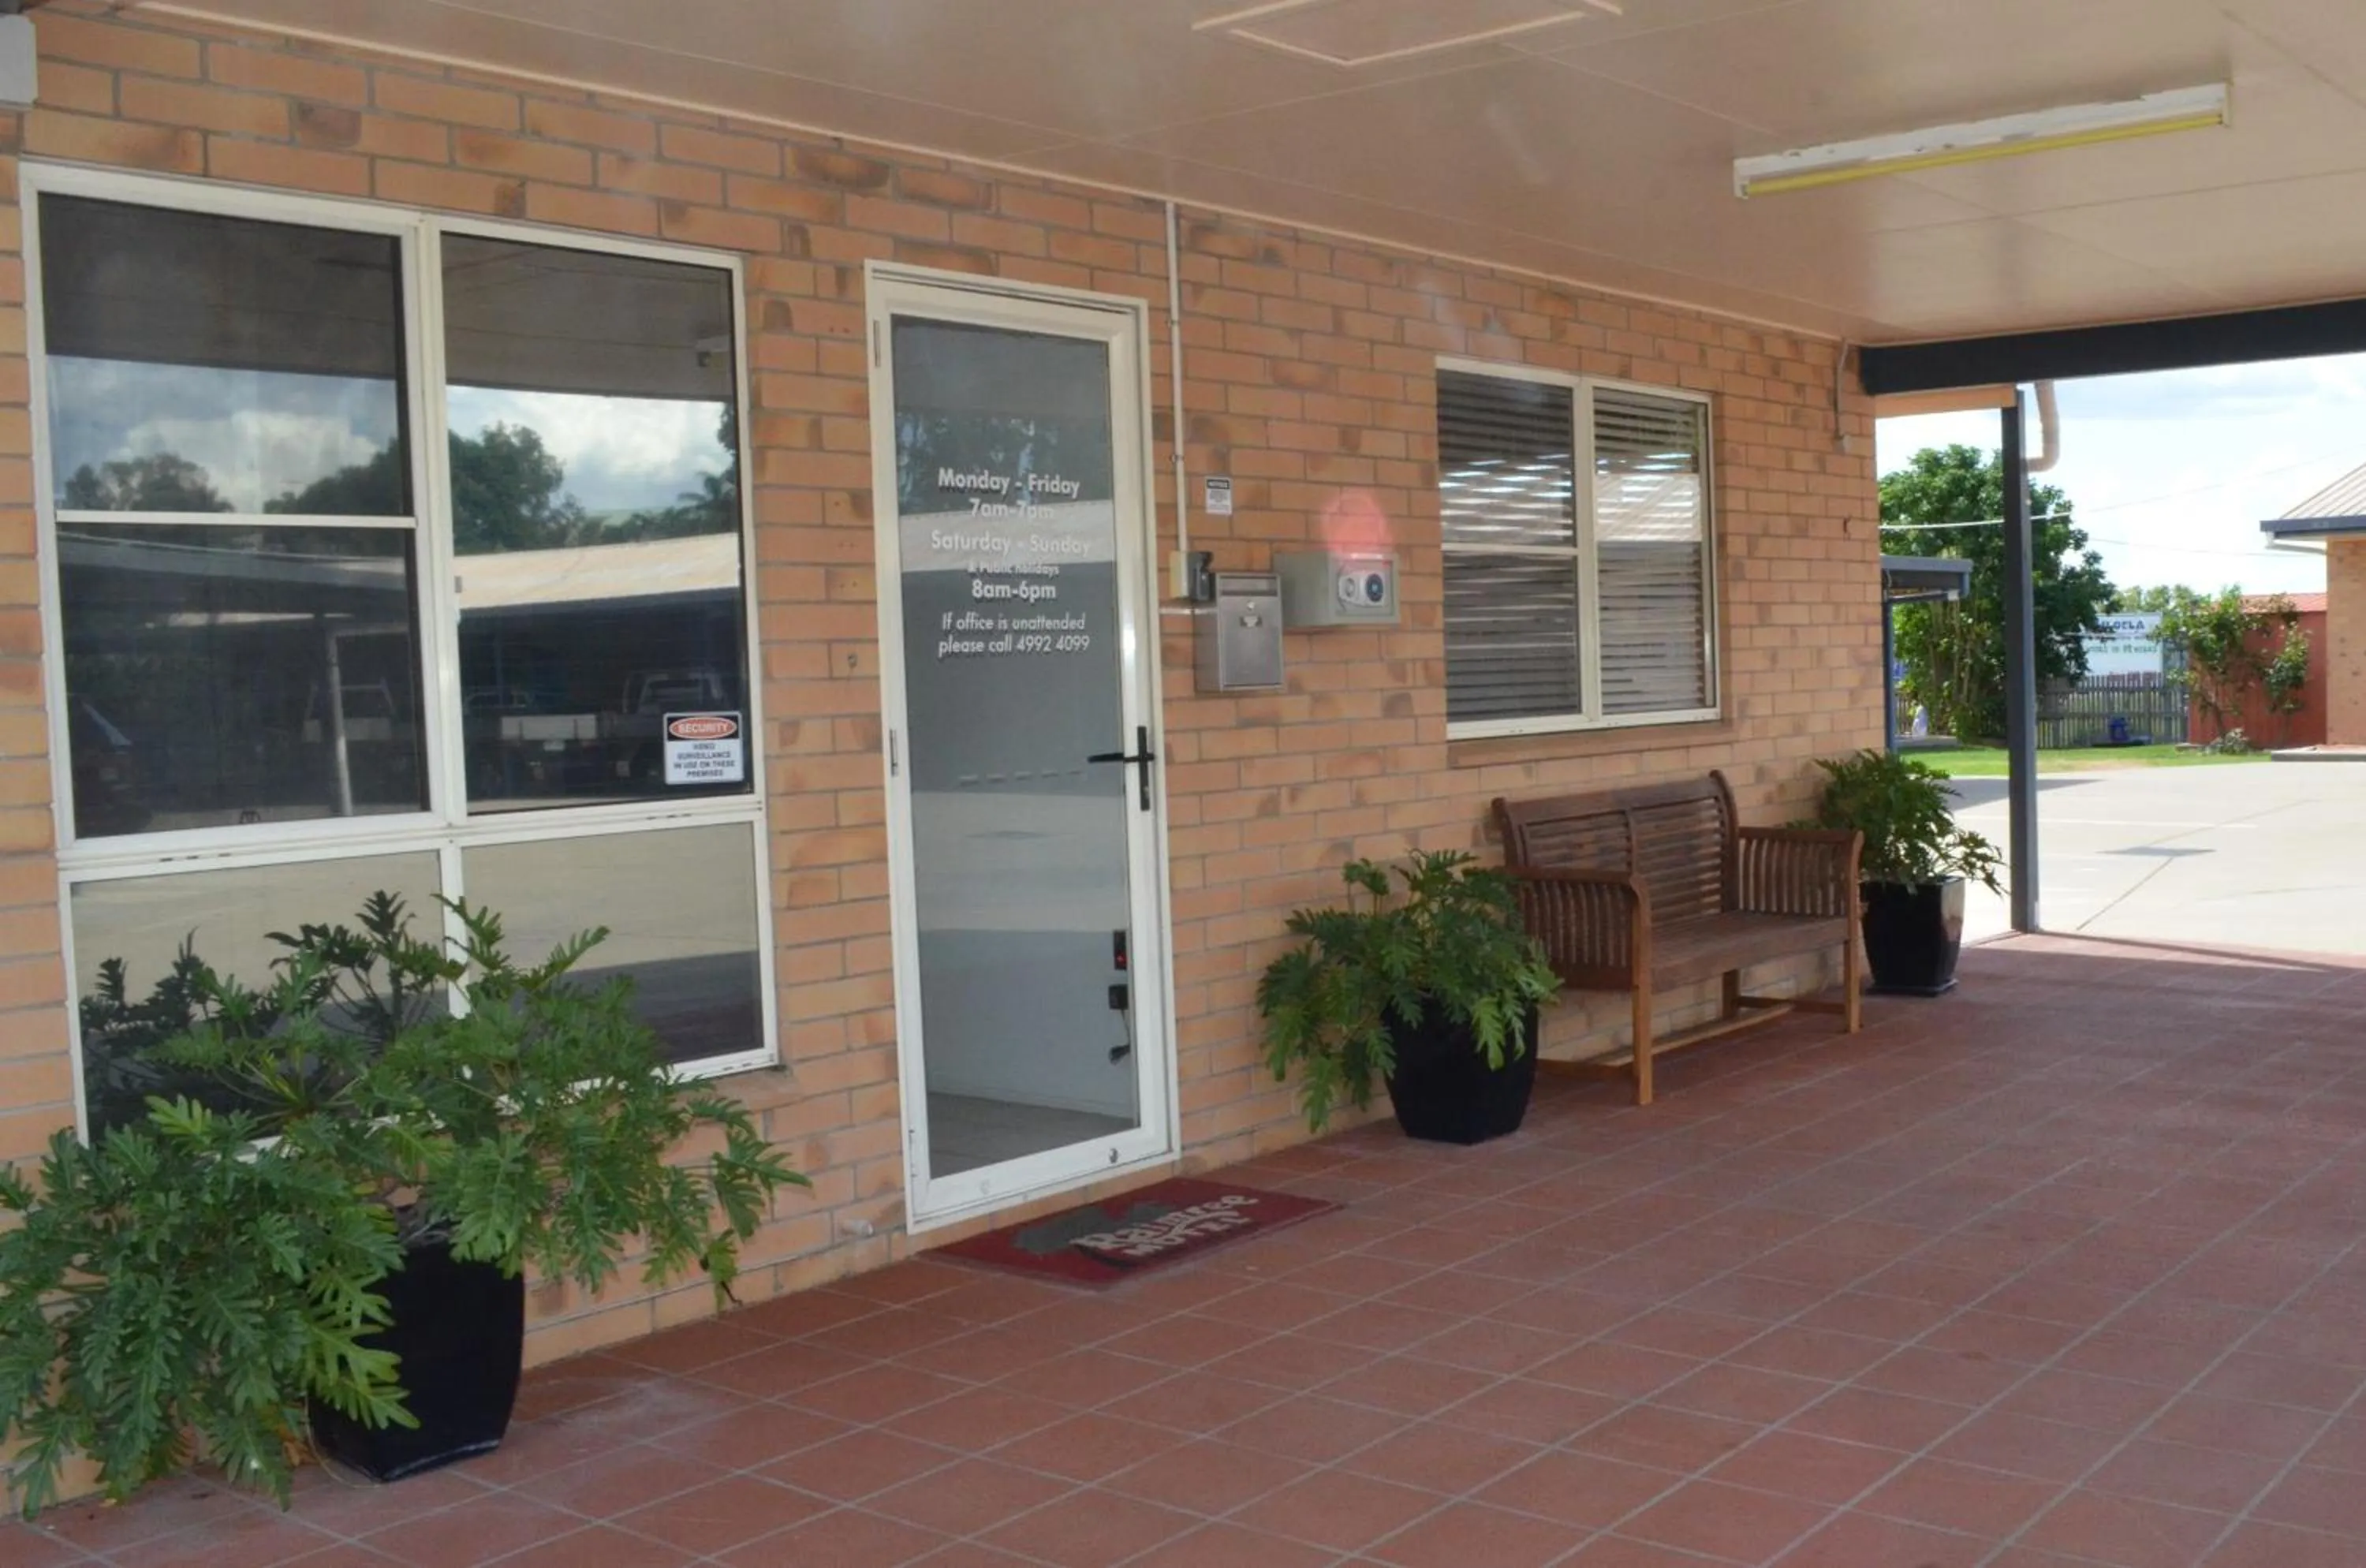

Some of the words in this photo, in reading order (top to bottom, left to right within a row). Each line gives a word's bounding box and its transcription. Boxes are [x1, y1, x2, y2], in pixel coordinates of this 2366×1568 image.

[938, 467, 1010, 495] Monday
[1028, 474, 1080, 498] Friday
[968, 498, 1054, 521] 7am-7pm
[931, 529, 1011, 555] Saturday
[1029, 534, 1092, 557] Sunday
[972, 578, 1057, 603] 8am-6pm
[942, 612, 953, 629] If
[956, 611, 995, 630] office
[998, 613, 1008, 629] is
[1011, 613, 1086, 630] unattended
[939, 634, 985, 658] please
[988, 634, 1013, 653] call
[1016, 635, 1052, 652] 4992
[1055, 635, 1091, 652] 4099
[678, 722, 729, 734] SECURITY
